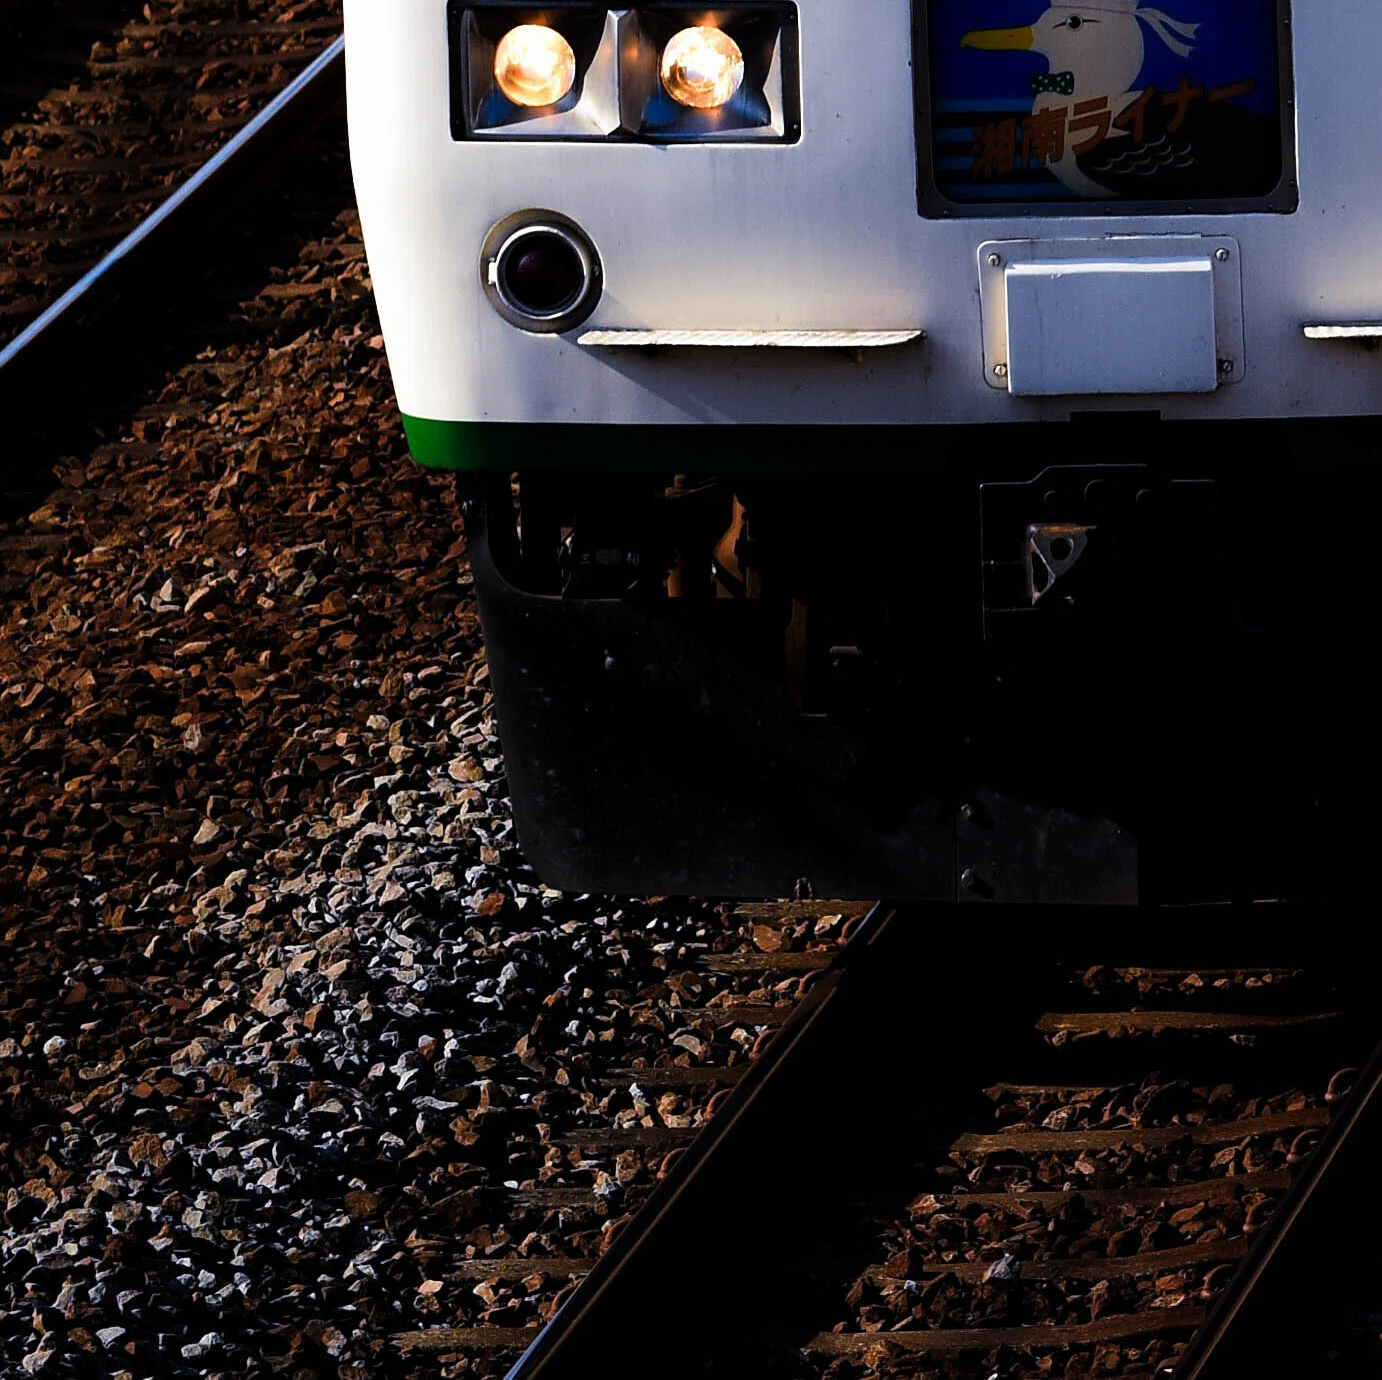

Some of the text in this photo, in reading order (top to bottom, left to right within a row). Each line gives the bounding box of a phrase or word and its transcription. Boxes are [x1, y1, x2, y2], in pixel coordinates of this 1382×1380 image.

[971, 76, 1256, 180] 湘南ライナー
